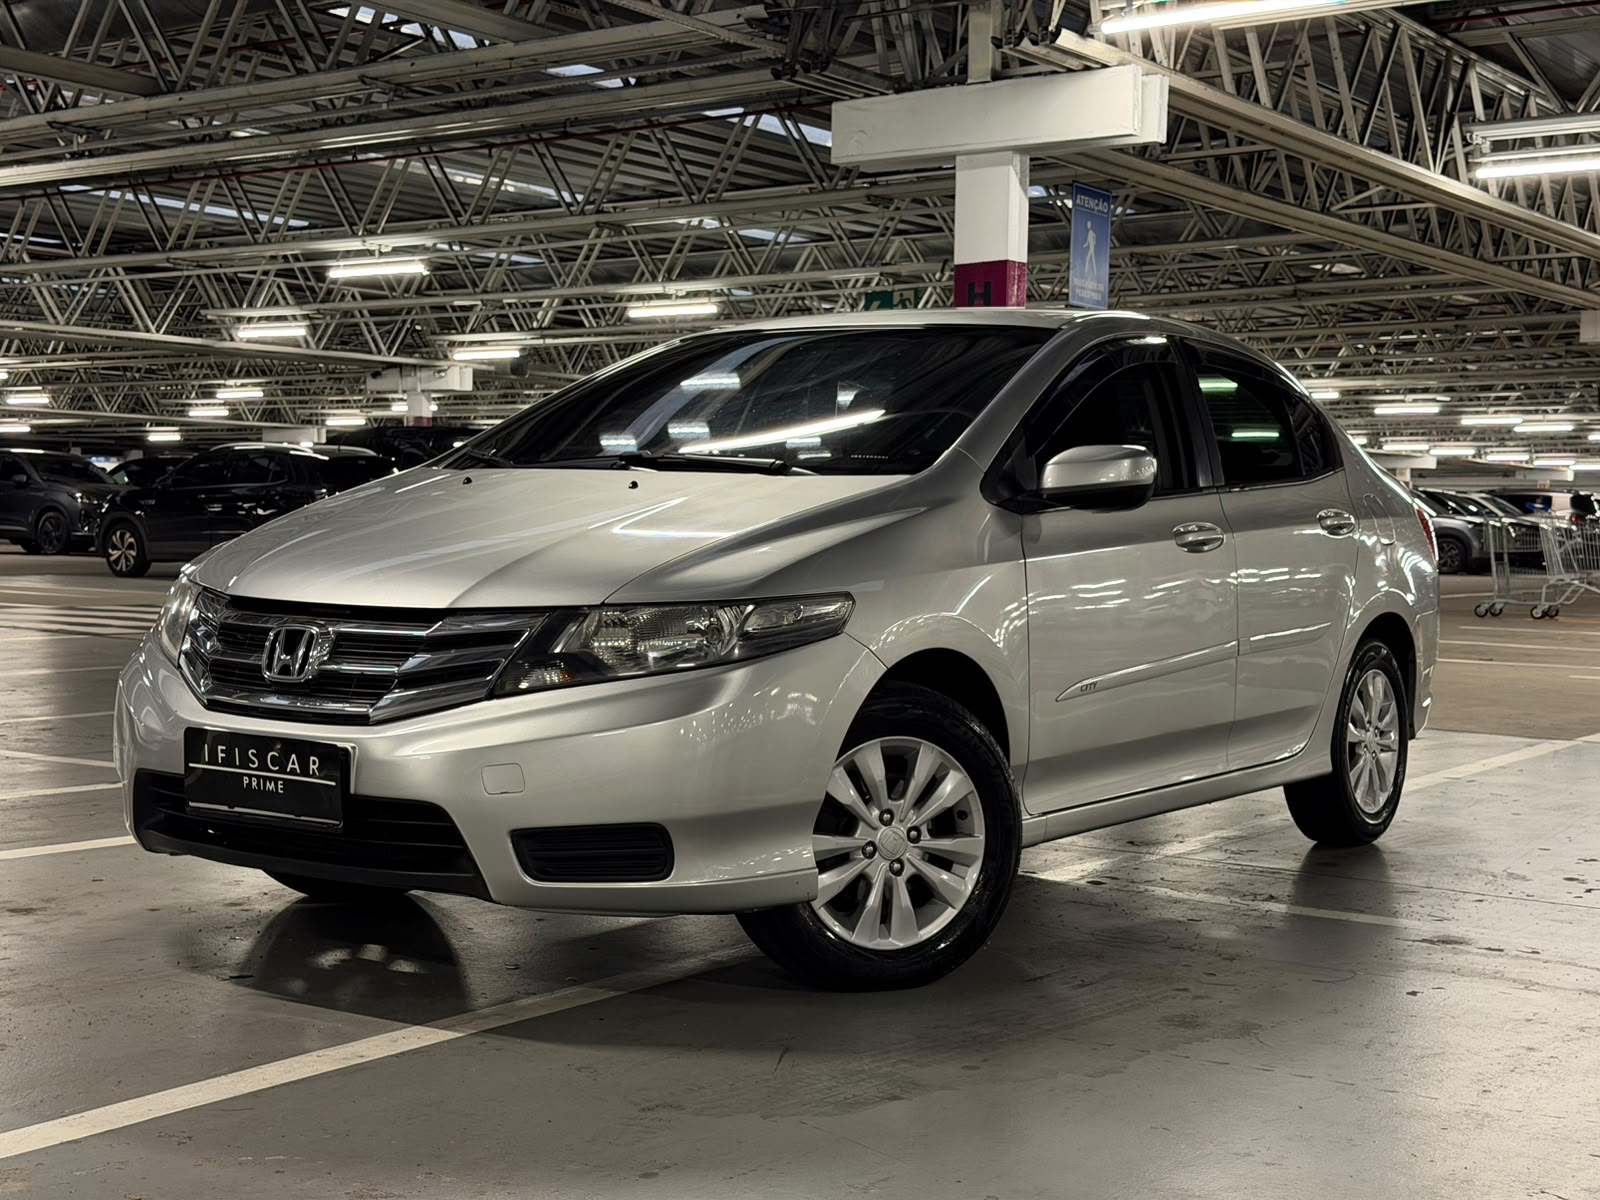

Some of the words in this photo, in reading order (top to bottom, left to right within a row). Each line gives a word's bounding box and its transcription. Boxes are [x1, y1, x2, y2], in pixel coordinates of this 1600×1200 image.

[1076, 194, 1109, 213] ATENÇÃO
[967, 281, 992, 306] H
[204, 743, 320, 776] IFISCAR
[243, 776, 284, 793] PRIME
